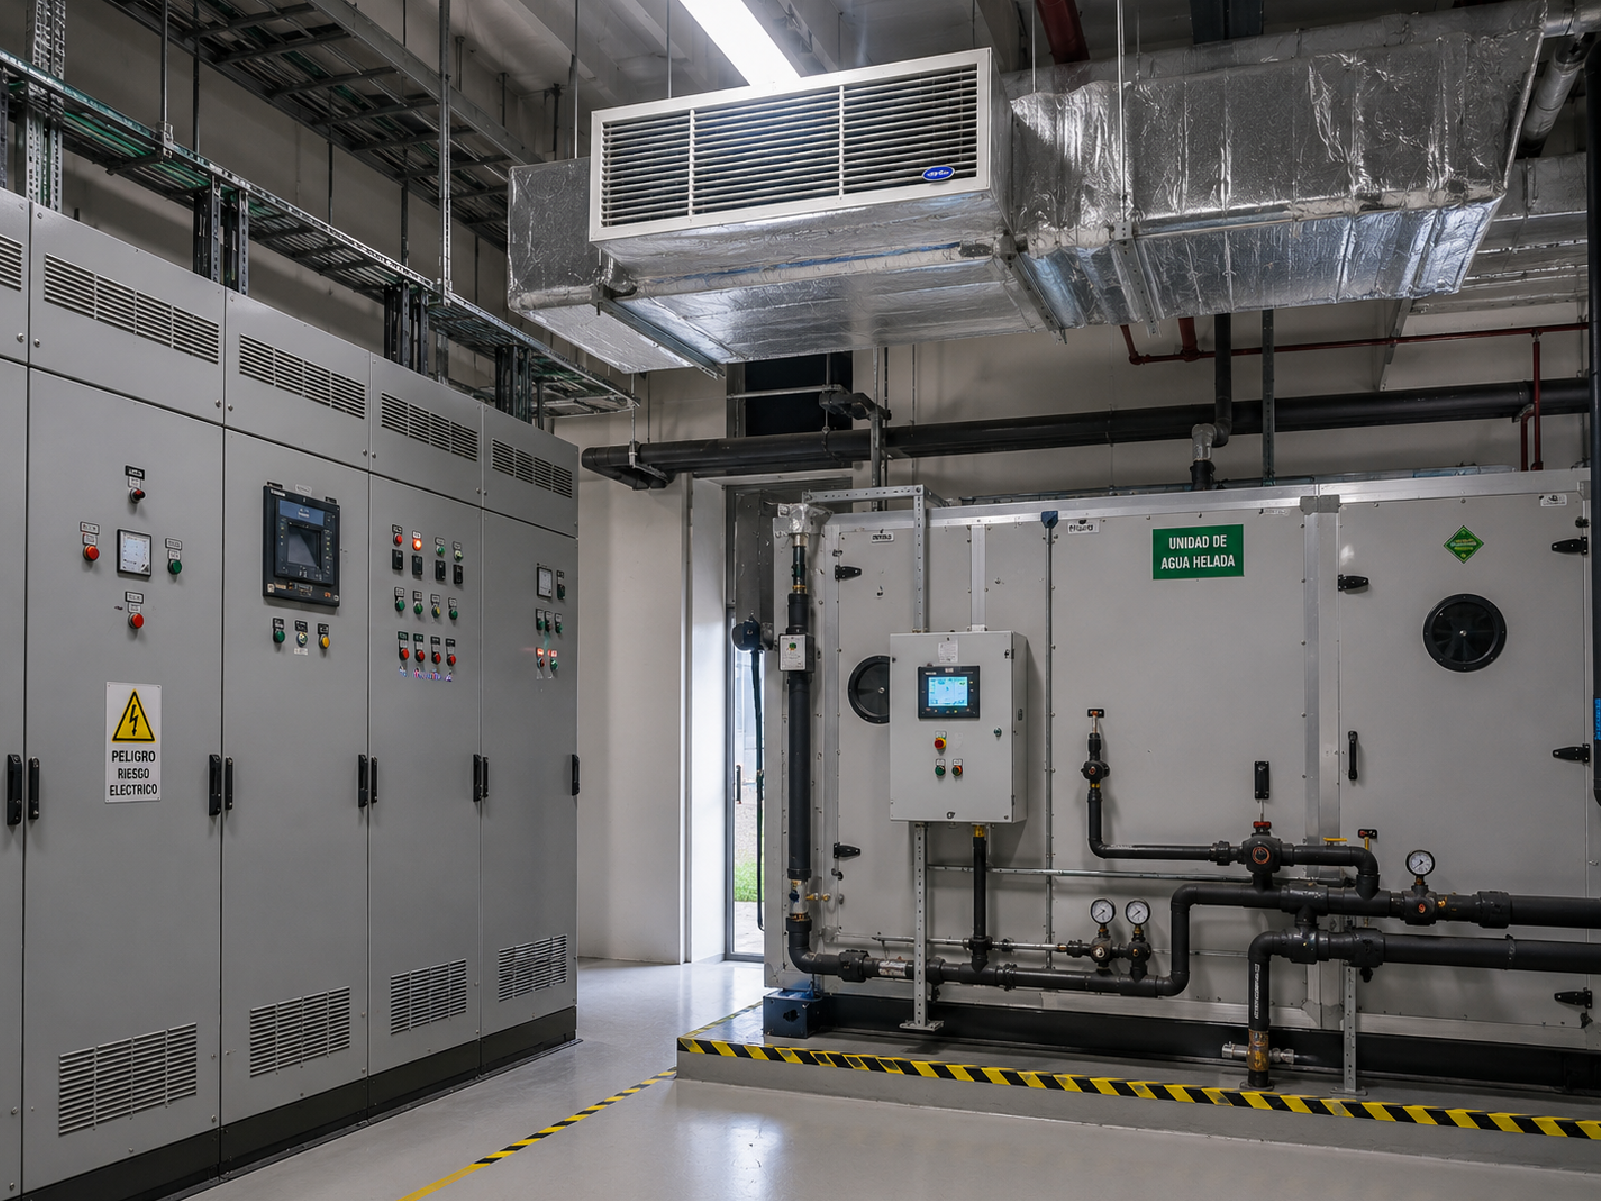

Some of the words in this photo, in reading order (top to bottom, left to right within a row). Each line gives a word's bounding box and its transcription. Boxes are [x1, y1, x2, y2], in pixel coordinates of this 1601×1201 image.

[1169, 536, 1210, 549] UNIDAD
[1213, 534, 1227, 547] DE
[1161, 556, 1190, 569] AGUA
[1193, 555, 1236, 568] HELADA
[111, 750, 156, 762] PELIGRO
[118, 768, 150, 779] RIESGO
